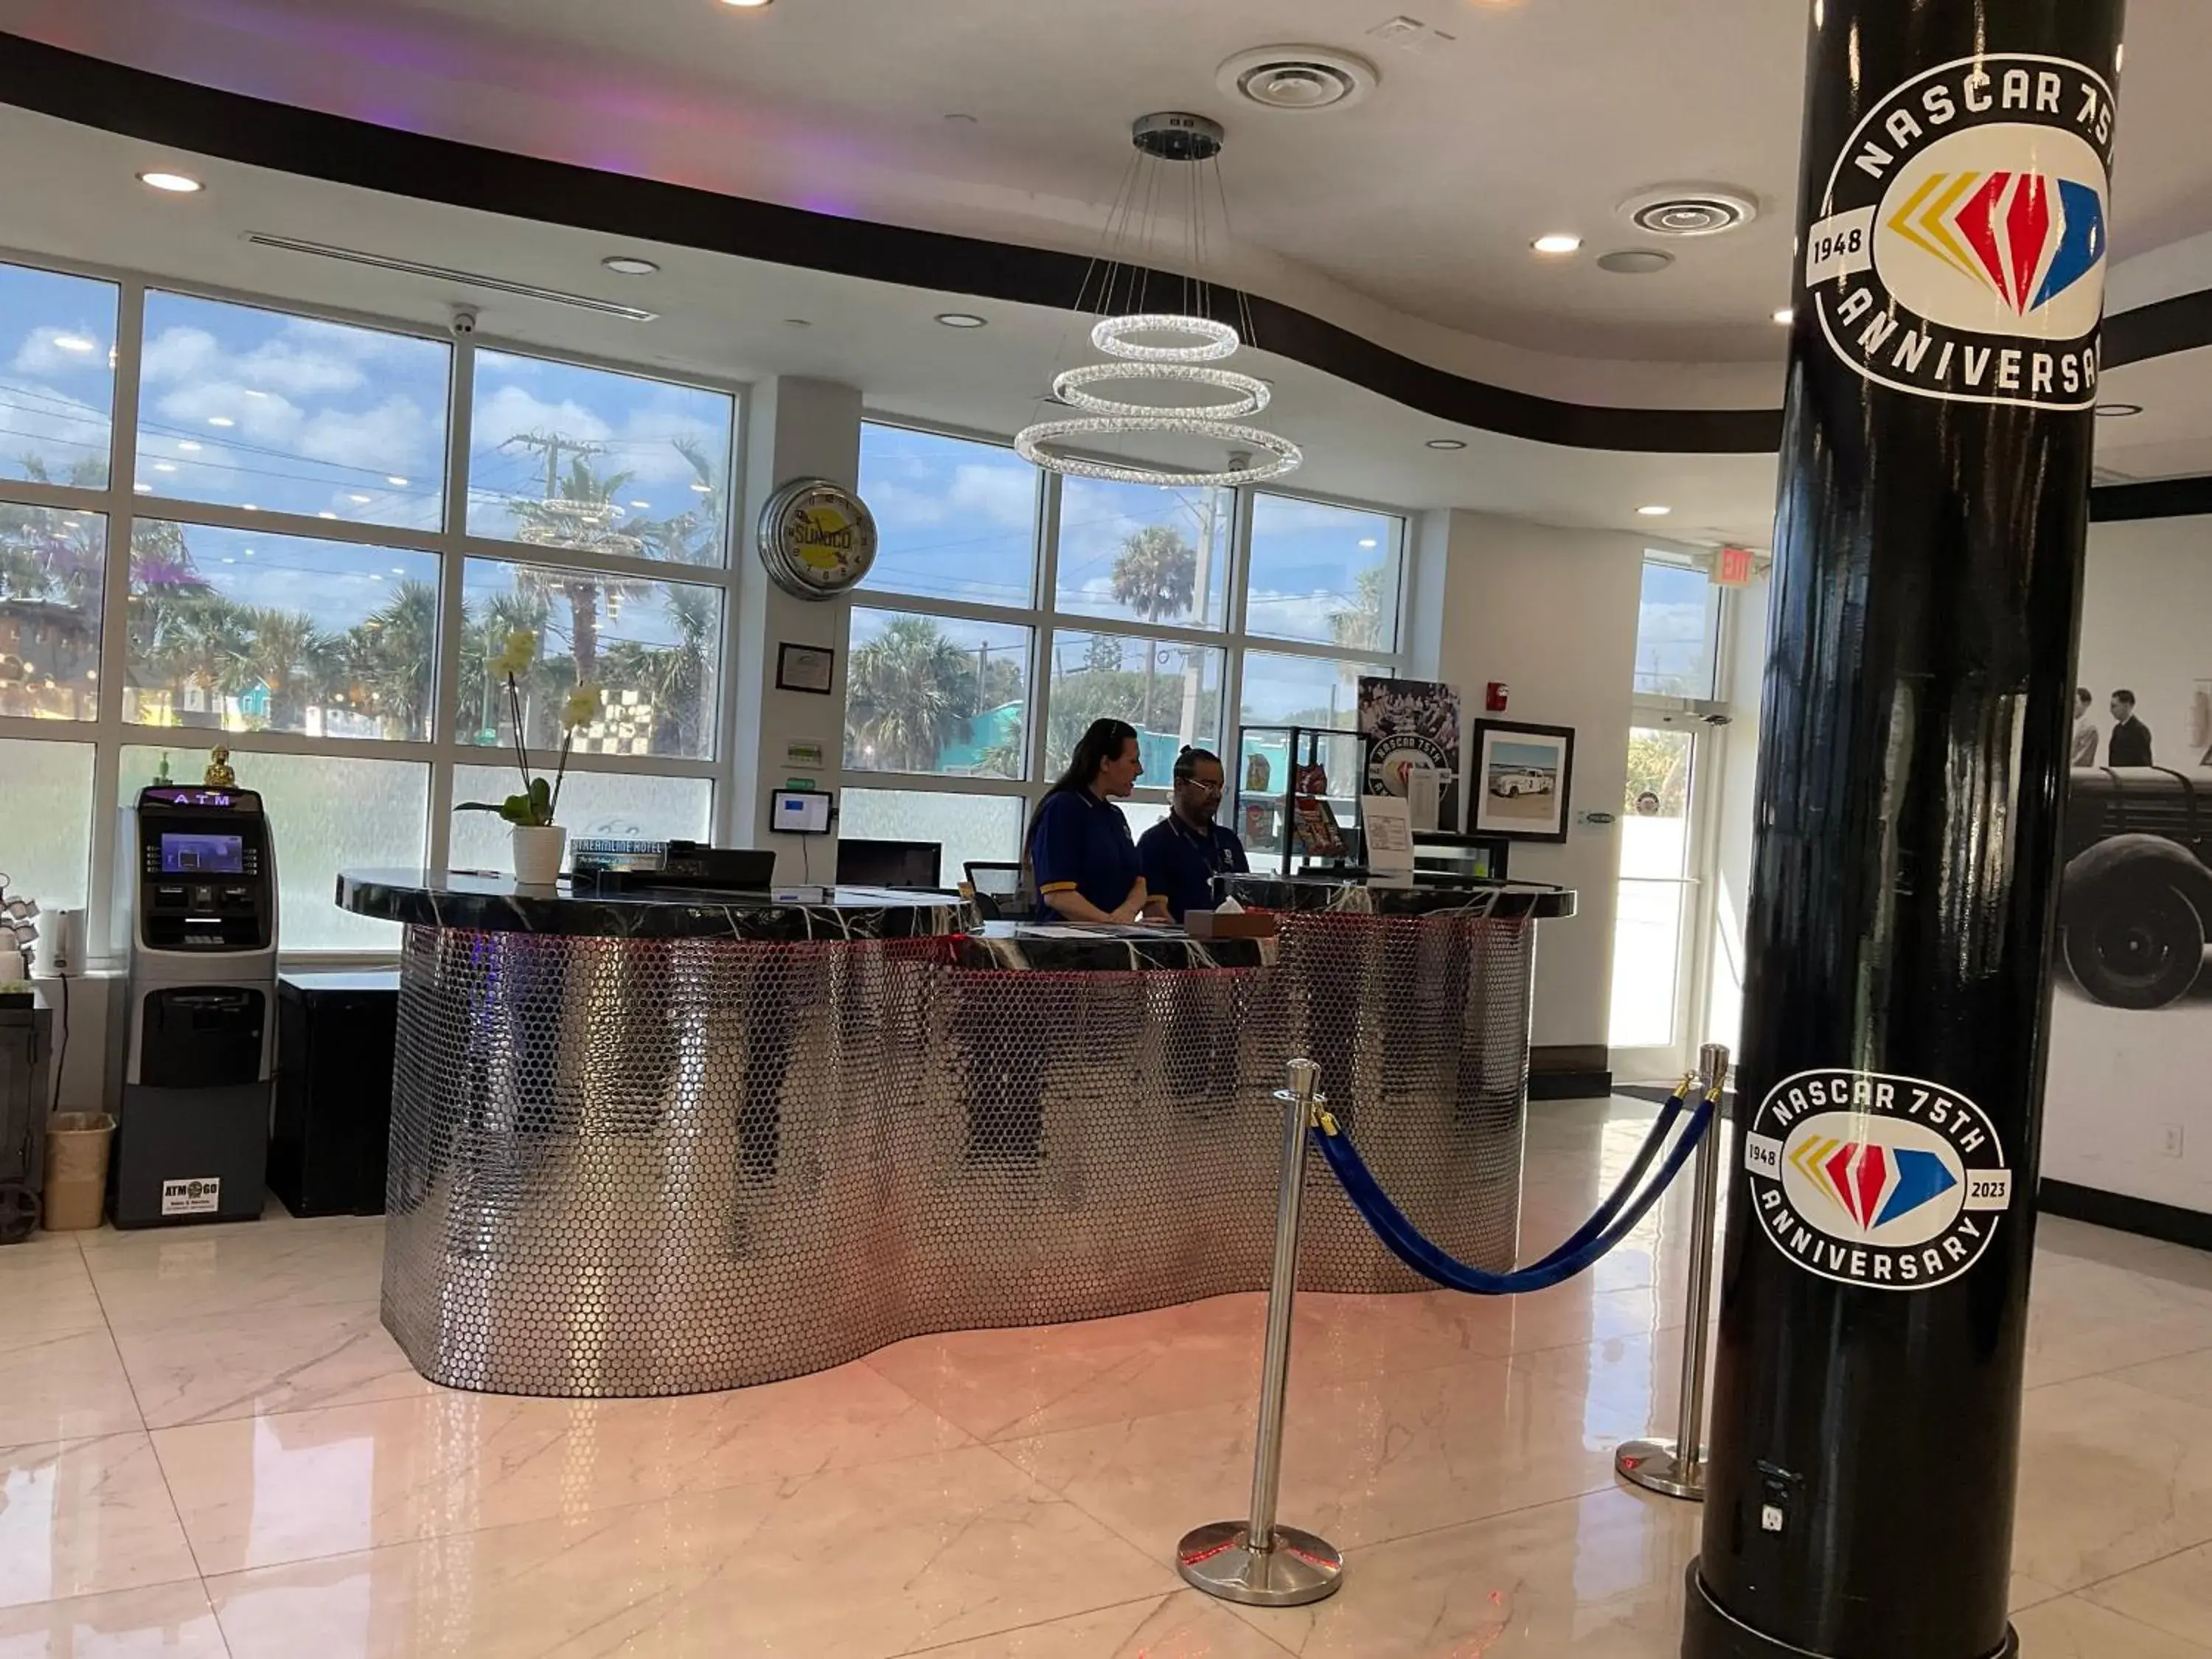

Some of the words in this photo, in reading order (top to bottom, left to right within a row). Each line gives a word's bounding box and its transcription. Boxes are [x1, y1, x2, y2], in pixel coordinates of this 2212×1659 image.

[1854, 69, 2062, 179] NASCAR
[2076, 83, 2114, 164] 75
[1813, 229, 1862, 264] 1948
[1837, 286, 2101, 394] ANNIVERSA
[1377, 737, 1416, 759] NASCAR
[174, 794, 230, 806] ATM
[1771, 1078, 1894, 1127] NASCAR
[1907, 1088, 1986, 1153] 75TH
[1749, 1143, 1775, 1166] 1948
[1971, 1181, 2006, 1198] 2023
[1761, 1189, 1981, 1280] ANNIVERSARY
